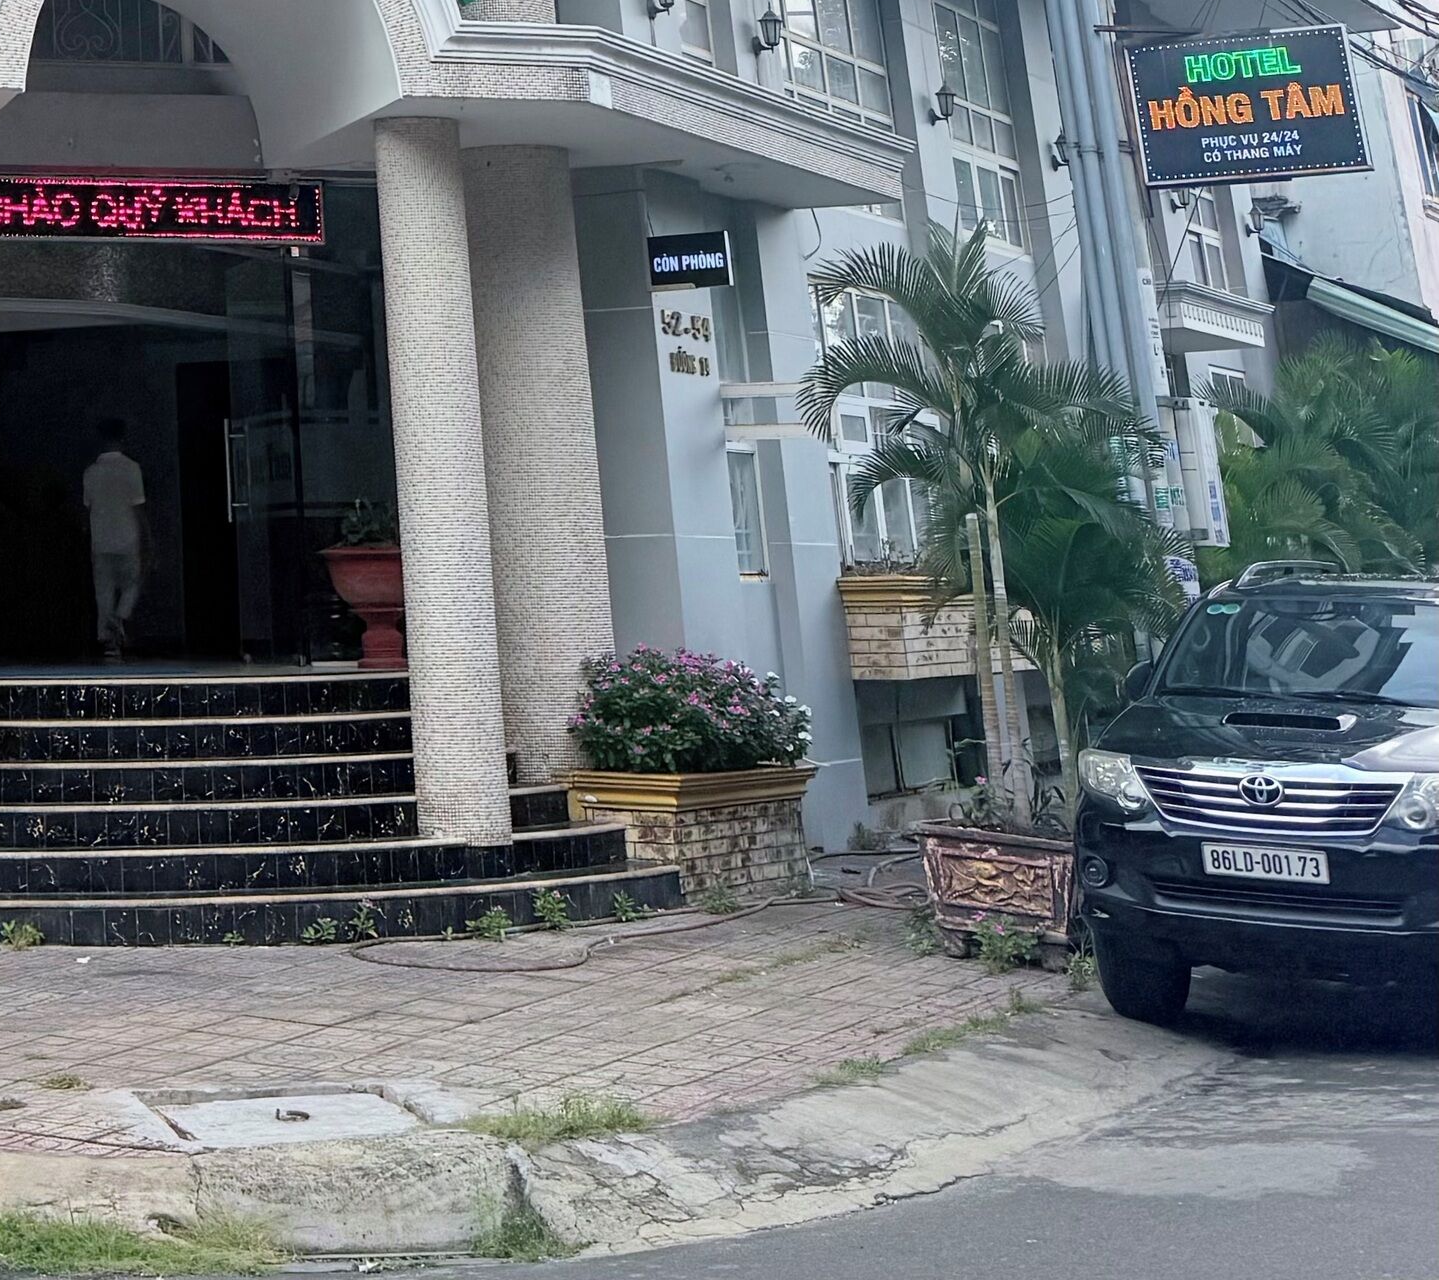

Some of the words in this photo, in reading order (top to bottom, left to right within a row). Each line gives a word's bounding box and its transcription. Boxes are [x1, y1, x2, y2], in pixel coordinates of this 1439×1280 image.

[1184, 46, 1302, 83] HOTEL
[1147, 86, 1254, 130] HỒNG
[1260, 81, 1345, 121] TÂM
[1201, 135, 1237, 149] PHỤC
[1240, 133, 1258, 146] VỤ
[1262, 130, 1300, 143] 24/24
[1203, 149, 1221, 162] CÓ
[1224, 147, 1270, 161] THANG
[1273, 143, 1302, 157] MÁY
[653, 253, 679, 272] CÒN
[682, 250, 724, 270] PHÒNG
[1211, 849, 1321, 877] 86LD-001.73
